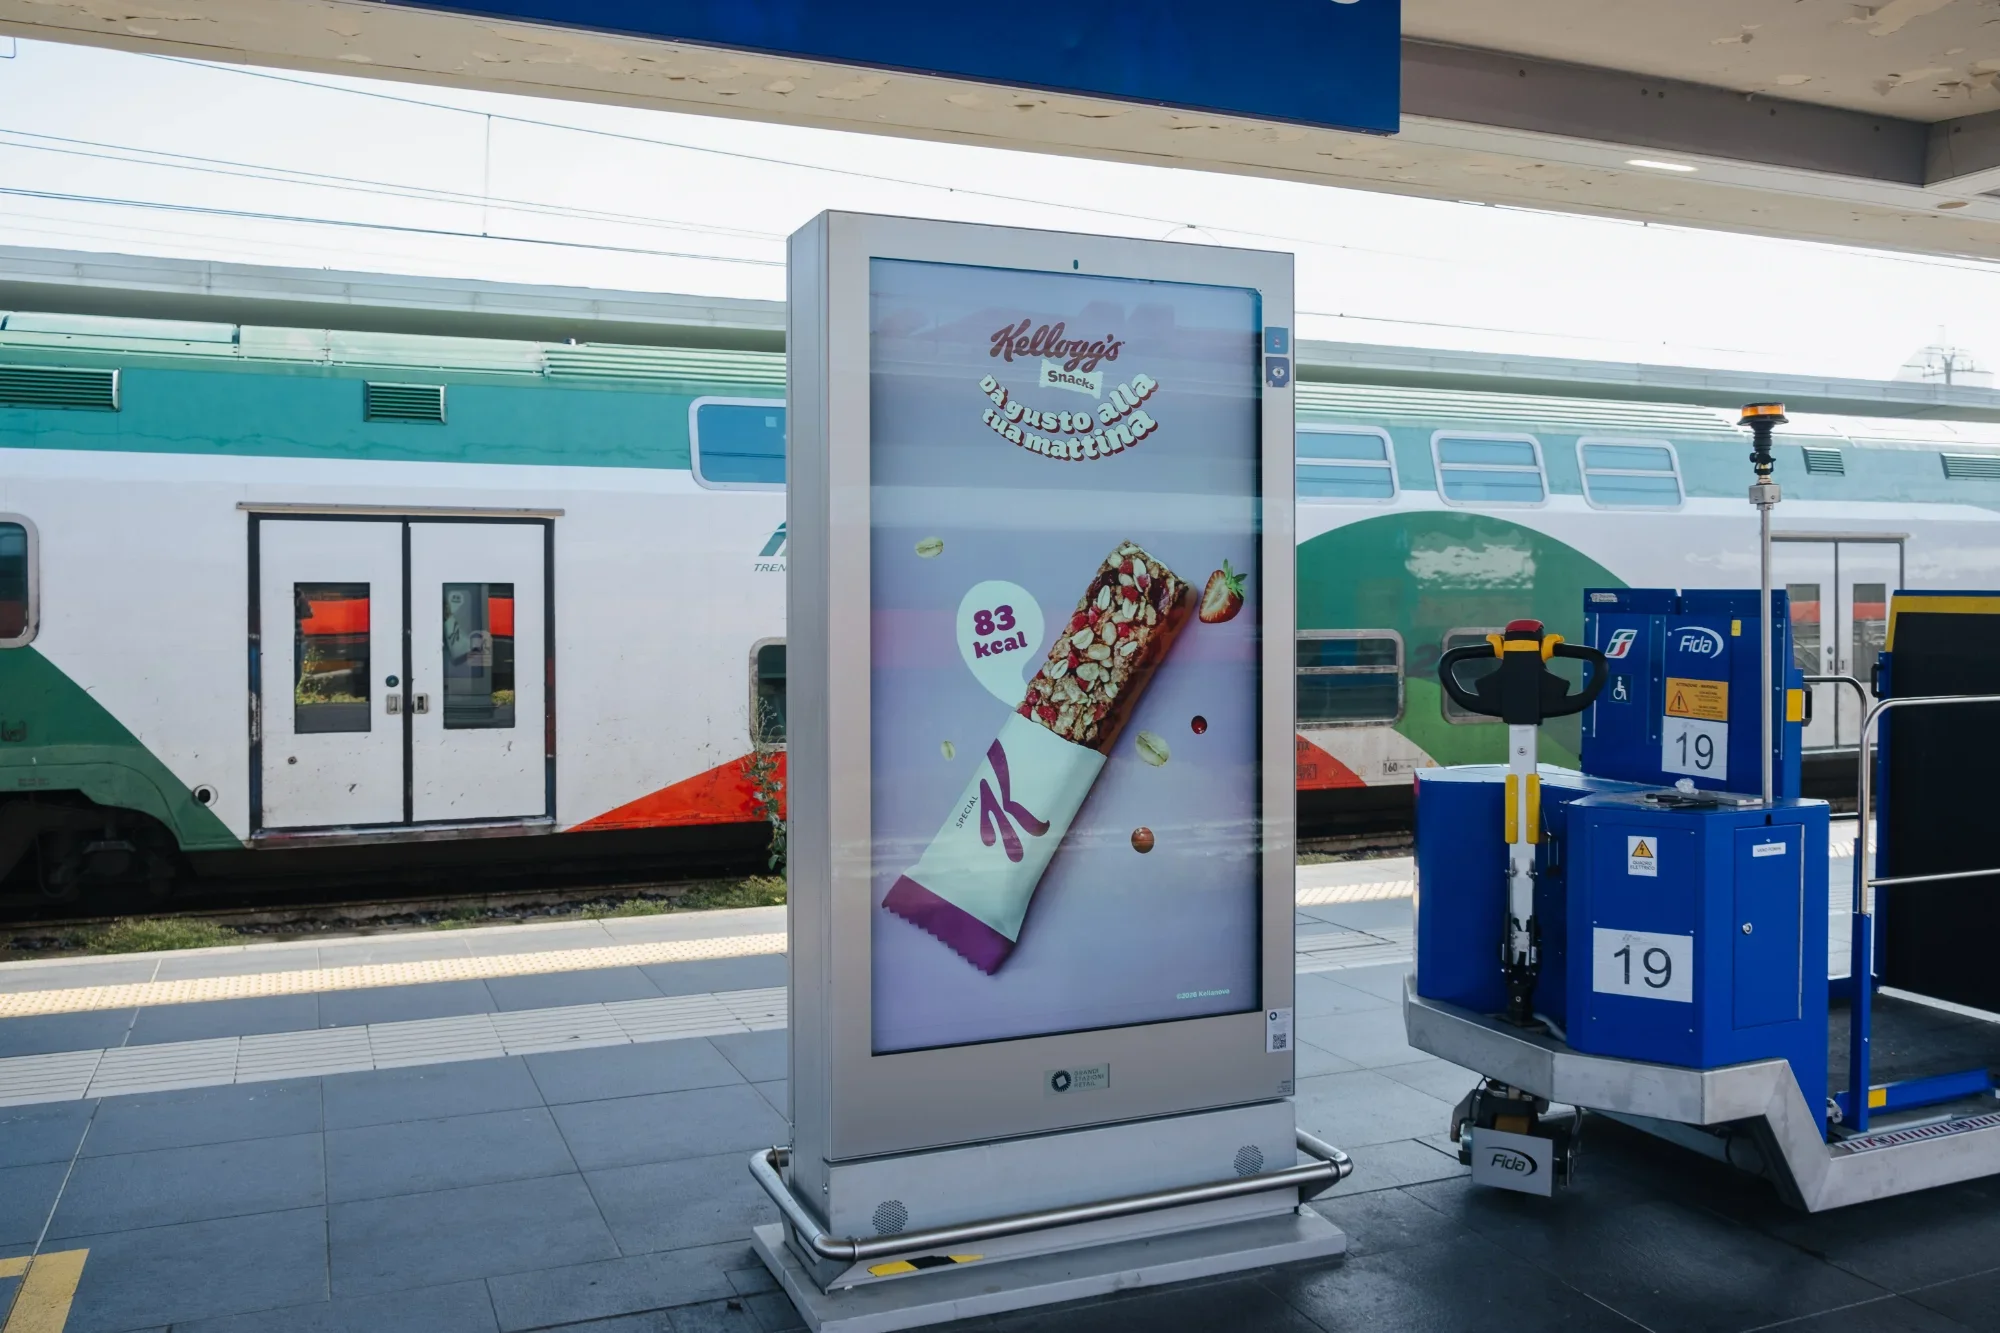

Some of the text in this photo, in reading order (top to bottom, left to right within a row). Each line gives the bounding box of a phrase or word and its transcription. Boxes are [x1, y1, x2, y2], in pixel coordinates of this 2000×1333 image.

[990, 318, 1123, 373] Kellogg's
[1047, 370, 1095, 390] Snacks
[1004, 400, 1094, 434] gusto
[1097, 373, 1159, 426] alla
[982, 408, 1158, 461] tua mattina
[973, 604, 1016, 636] 83
[973, 631, 1028, 659] kcal
[1679, 634, 1713, 653] Fida
[1675, 732, 1714, 770] 19
[1383, 762, 1398, 773] 160
[955, 738, 1051, 863] SPECIAL K
[1613, 944, 1672, 989] 19
[1074, 1068, 1099, 1076] GRANDI
[1074, 1074, 1104, 1082] STAZIONI
[1491, 1153, 1526, 1172] Fida
